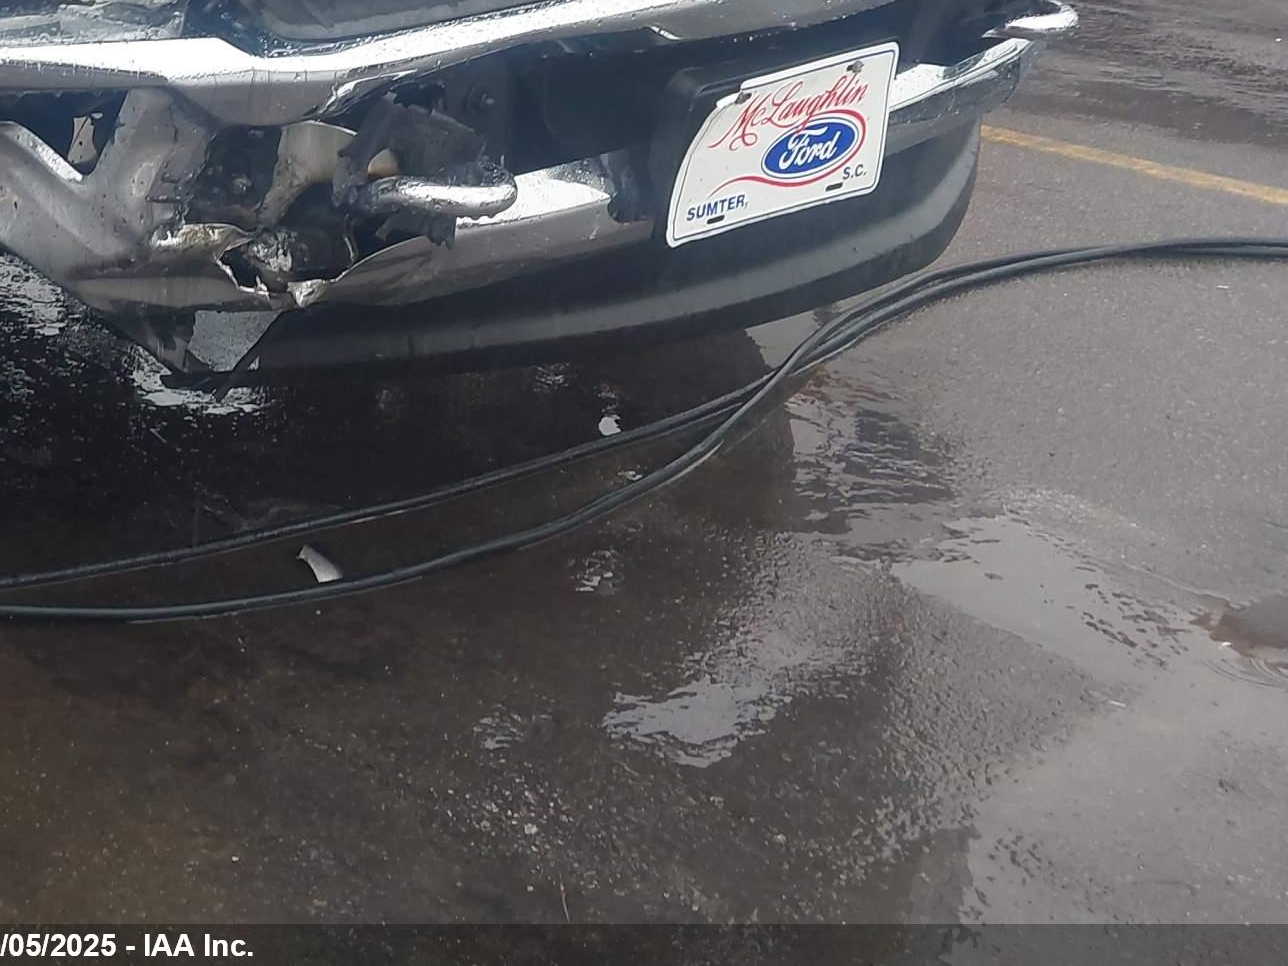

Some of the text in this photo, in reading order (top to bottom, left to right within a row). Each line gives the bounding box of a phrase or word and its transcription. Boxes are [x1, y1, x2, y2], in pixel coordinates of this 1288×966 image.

[778, 126, 842, 170] Ford
[686, 164, 867, 221] SUMTER, S.C.
